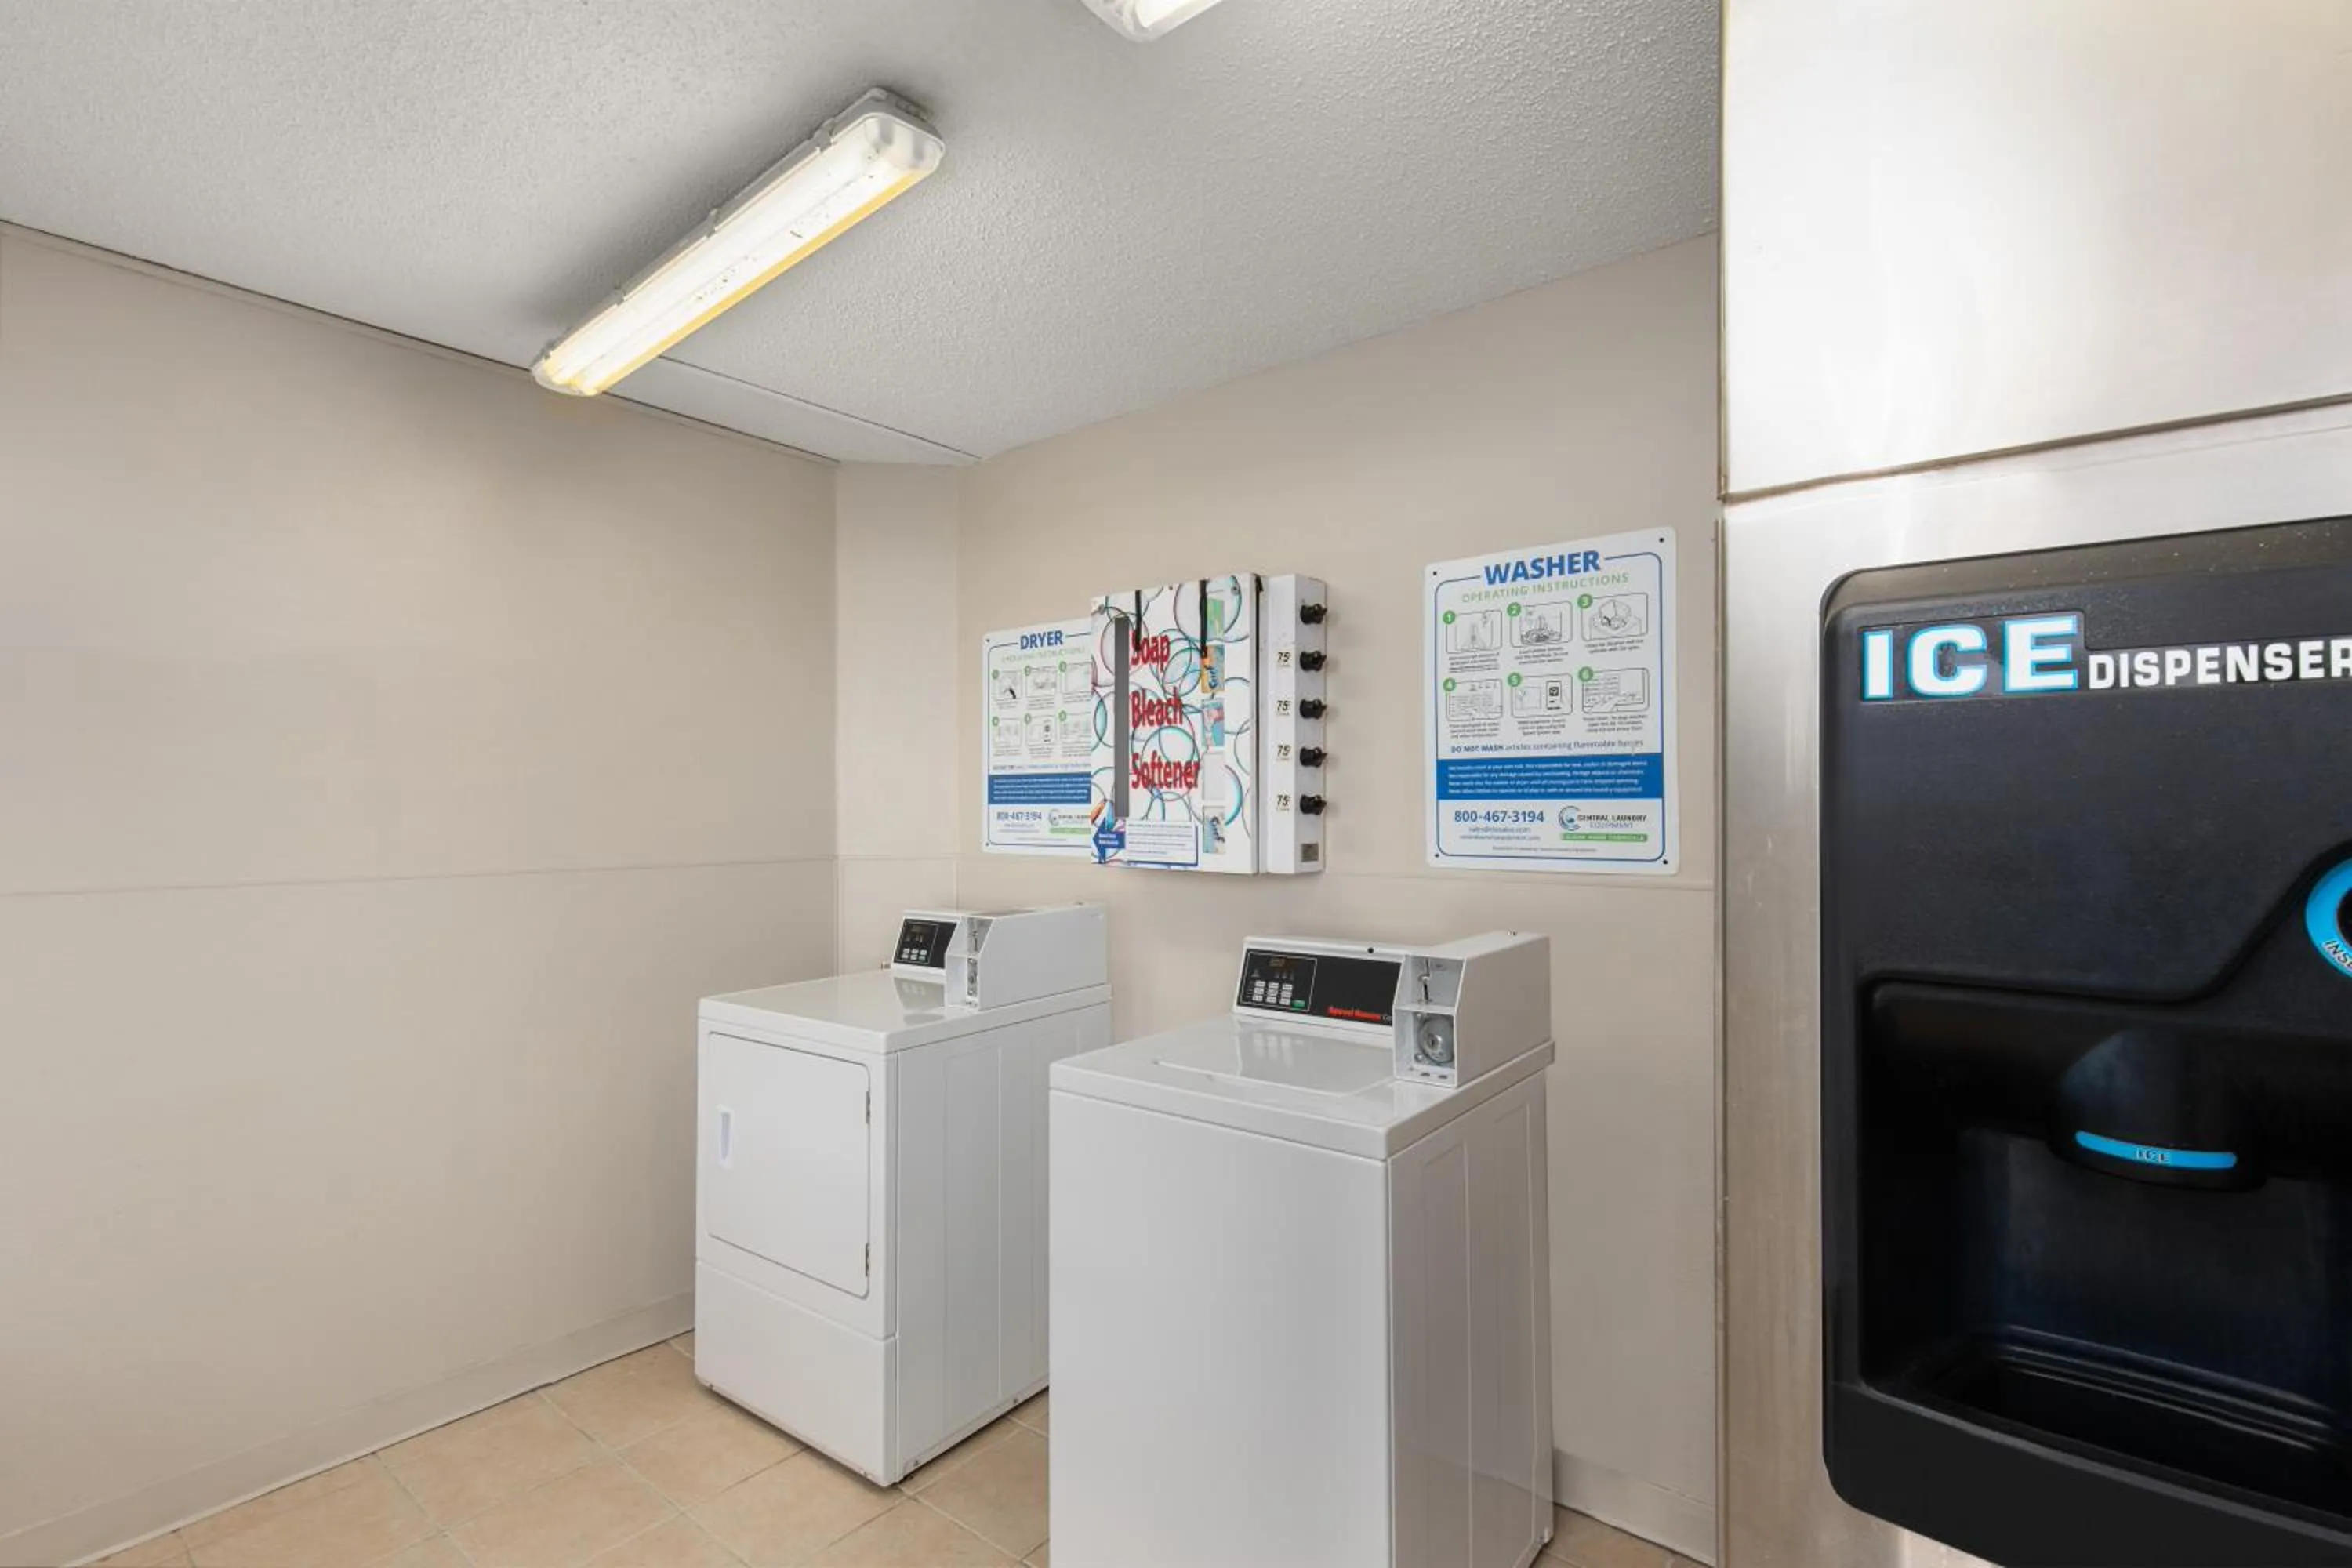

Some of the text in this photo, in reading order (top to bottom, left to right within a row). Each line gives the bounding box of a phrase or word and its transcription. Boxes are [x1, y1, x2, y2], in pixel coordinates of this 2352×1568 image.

[1485, 550, 1601, 585] WASHER
[1462, 572, 1629, 603] OPERATING INSTRUCTIONS
[1020, 630, 1063, 650] DRYER
[1131, 628, 1171, 673] Soap
[1861, 613, 2352, 700] ICE DISPENSER
[1131, 686, 1183, 728] Bleach
[1131, 750, 1200, 789] Softener
[1454, 810, 1544, 822] 800-467-3194
[2135, 1147, 2171, 1164] ICE
